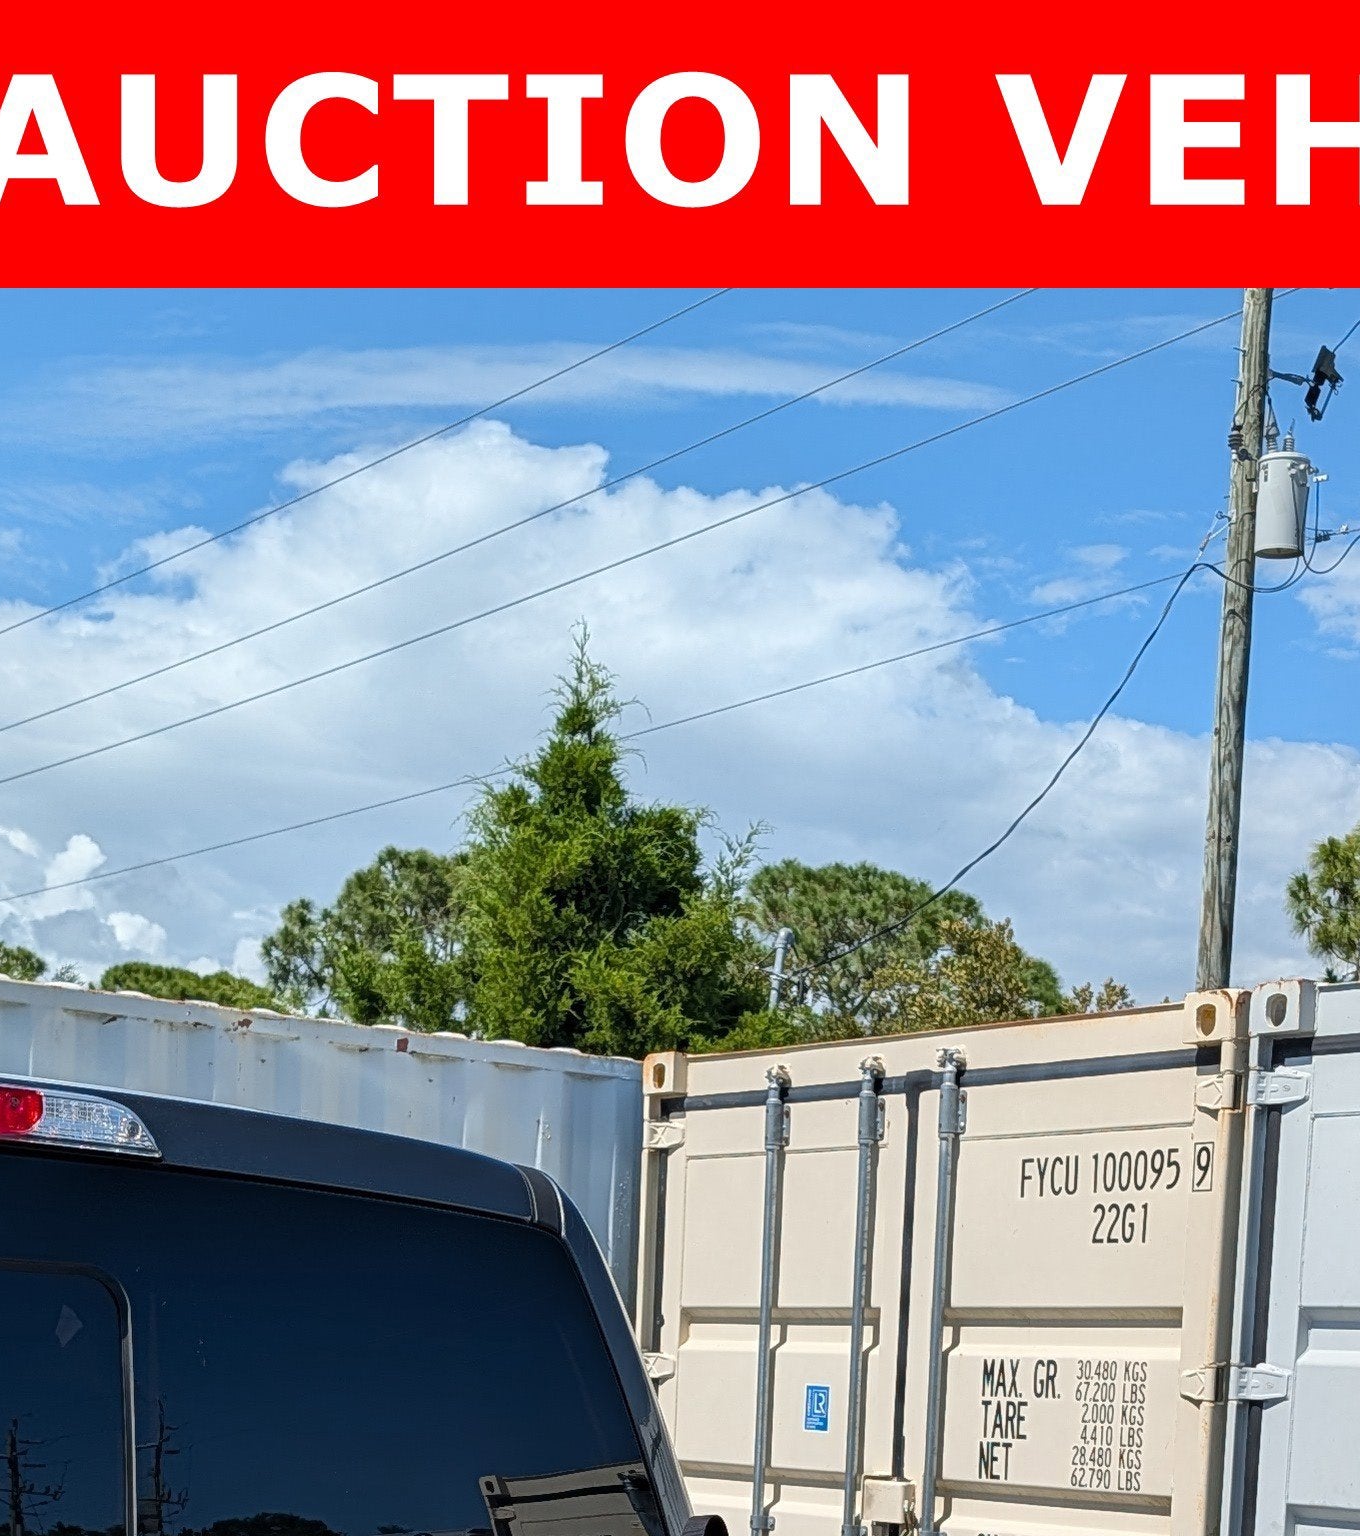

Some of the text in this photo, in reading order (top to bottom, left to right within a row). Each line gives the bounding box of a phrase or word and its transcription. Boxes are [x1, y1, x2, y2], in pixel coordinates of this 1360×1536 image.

[1020, 1146, 1212, 1198] FYCU 100095 9
[1092, 1203, 1149, 1244] 22G1
[982, 1359, 1061, 1399] MAX. GR.
[1124, 1361, 1148, 1382] KGS
[1122, 1383, 1146, 1404] LBS
[981, 1400, 1028, 1439] TARE
[1121, 1405, 1145, 1426] KGS
[1120, 1427, 1143, 1448] LBS
[978, 1441, 1013, 1481] NET
[1119, 1449, 1142, 1470] KGS
[1118, 1470, 1141, 1491] LBS
